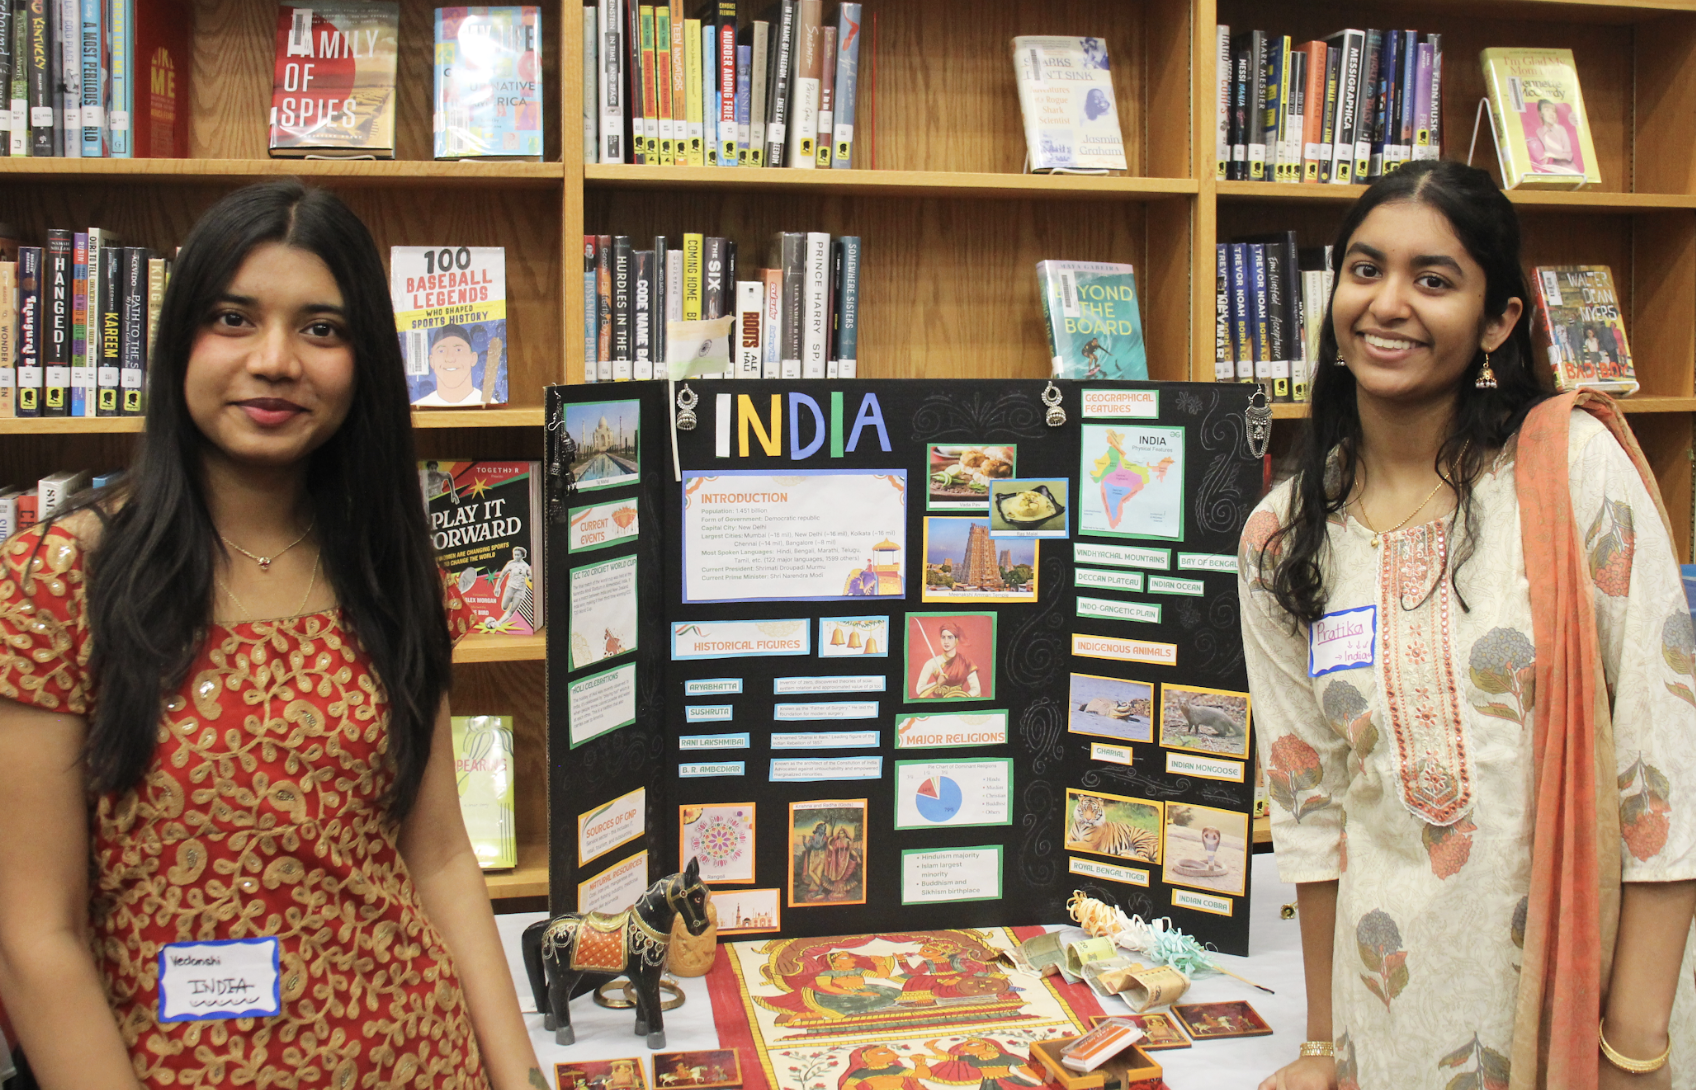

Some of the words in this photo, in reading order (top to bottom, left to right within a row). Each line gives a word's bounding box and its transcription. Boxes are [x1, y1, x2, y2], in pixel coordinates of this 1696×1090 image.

[783, 6, 792, 14] IN
[783, 14, 791, 25] THE
[608, 35, 616, 44] IN
[672, 21, 683, 45] TEEN
[781, 25, 790, 42] NAME
[32, 17, 46, 70] KENTUCKY
[83, 32, 97, 59] MOST
[723, 31, 733, 66] MURDER
[781, 43, 788, 51] OF
[1259, 38, 1267, 65] MARK
[673, 47, 684, 91] INNOVATORS
[779, 51, 787, 78] FREEDOM
[1238, 58, 1247, 82] MESSI
[284, 63, 315, 92] OF
[609, 66, 617, 82] AND
[1065, 71, 1093, 80] SINK
[83, 62, 98, 106] PERILOUS
[723, 68, 733, 99] AMONG
[1258, 69, 1267, 109] MESSIER
[1343, 47, 1359, 130] MESSIGRAPHICA
[609, 84, 618, 105] SPACE
[1237, 83, 1246, 107] MANIA
[281, 98, 356, 128] SPIES
[1042, 106, 1064, 114] Shark
[1038, 116, 1070, 125] Scientist
[1083, 135, 1121, 144] Jasmin
[1079, 146, 1122, 155] Graham
[77, 241, 85, 262] RUBIN
[424, 247, 471, 274] 100
[687, 240, 698, 274] COMING
[814, 241, 823, 287] PRINCE
[846, 243, 857, 294] SOMEWHERE
[1254, 249, 1265, 288] TREVOR
[406, 269, 492, 293] BASEBALL
[616, 256, 627, 308] HURDLES
[707, 260, 721, 291] SIX
[1566, 271, 1610, 287] WALTER
[413, 286, 488, 309] LEGENDS
[636, 279, 648, 310] CODE
[686, 276, 697, 301] HOME
[1582, 288, 1614, 303] DEAN
[54, 257, 65, 358] HANGED!
[426, 308, 442, 317] WHO
[445, 305, 474, 315] SHAPED
[812, 292, 822, 334] HARRY
[845, 297, 855, 329] SISTERS
[1078, 301, 1115, 318] THE
[1256, 290, 1266, 318] NOAH
[411, 316, 446, 329] SPORTS
[449, 311, 488, 325] HISTORY
[616, 313, 627, 325] IN
[1580, 305, 1618, 322] MYERS
[104, 312, 119, 358] KAREEM
[636, 312, 648, 346] NAME
[742, 311, 760, 348] ROOTS
[1064, 318, 1133, 336] BOARD
[1258, 322, 1267, 345] BORN
[616, 330, 627, 351] THE
[1564, 362, 1596, 380] BAD
[1600, 361, 1629, 378] BOY
[1085, 393, 1154, 402] GEOGRAPHICAL
[1085, 405, 1131, 413] FEATURES
[716, 391, 892, 460] INDIA
[1139, 436, 1167, 445] INDIA
[701, 492, 788, 504] INTRODUCTION
[431, 504, 479, 531] PLAY
[484, 499, 506, 519] IT
[580, 518, 608, 532] CURRENT
[580, 532, 605, 545] EVENTS
[466, 546, 491, 556] CHANGING
[491, 542, 510, 551] SPORTS
[1076, 549, 1123, 560] VINDHYACHAL
[1124, 554, 1165, 564] MOUNTAINS
[450, 558, 469, 566] CHANGE
[479, 551, 496, 560] WORLD
[1209, 560, 1238, 568] BENGAL
[581, 570, 590, 578] T20
[591, 565, 609, 576] CRICKET
[610, 561, 626, 572] WORLD
[627, 558, 637, 567] CUP
[1078, 573, 1107, 582] DECCAN
[1108, 576, 1139, 586] PLATEAU
[1151, 580, 1175, 589] INDIAN
[1176, 583, 1201, 591] OCEAN
[1080, 603, 1135, 616] INDO-GANGETIC
[1136, 609, 1156, 618] PLAIN
[1317, 620, 1364, 642] Pratika
[694, 640, 754, 651] HISTORICAL
[757, 640, 800, 650] FIGURES
[1077, 641, 1131, 653] INDIGENOUS
[1133, 647, 1171, 657] ANIMALS
[1344, 650, 1368, 662] India
[689, 682, 737, 691] ARYABHATTA
[690, 708, 729, 716] SUSHRUTA
[681, 739, 698, 747] RANI
[700, 738, 744, 746] LAKSHMIBAI
[906, 734, 943, 745] MAJOR
[945, 732, 1005, 743] RELIGIONS
[1096, 747, 1125, 758] GHARIAL
[1171, 760, 1194, 770] INDIAN
[1195, 764, 1239, 776] MONGOOSE
[586, 818, 614, 838] SOURCES
[615, 815, 623, 825] OF
[624, 808, 637, 821] GNP
[953, 852, 980, 860] majority
[589, 875, 612, 890] NATURAL
[613, 857, 643, 878] RESOURCES
[1073, 862, 1095, 872] ROYAL
[1096, 866, 1123, 877] BENGAL
[1125, 872, 1145, 882] TIGER
[948, 887, 980, 896] birthplace
[1178, 895, 1202, 905] INDIAN
[1203, 900, 1228, 910] COBRA
[170, 956, 221, 967] Vedanshi
[187, 978, 254, 995] INDIA
